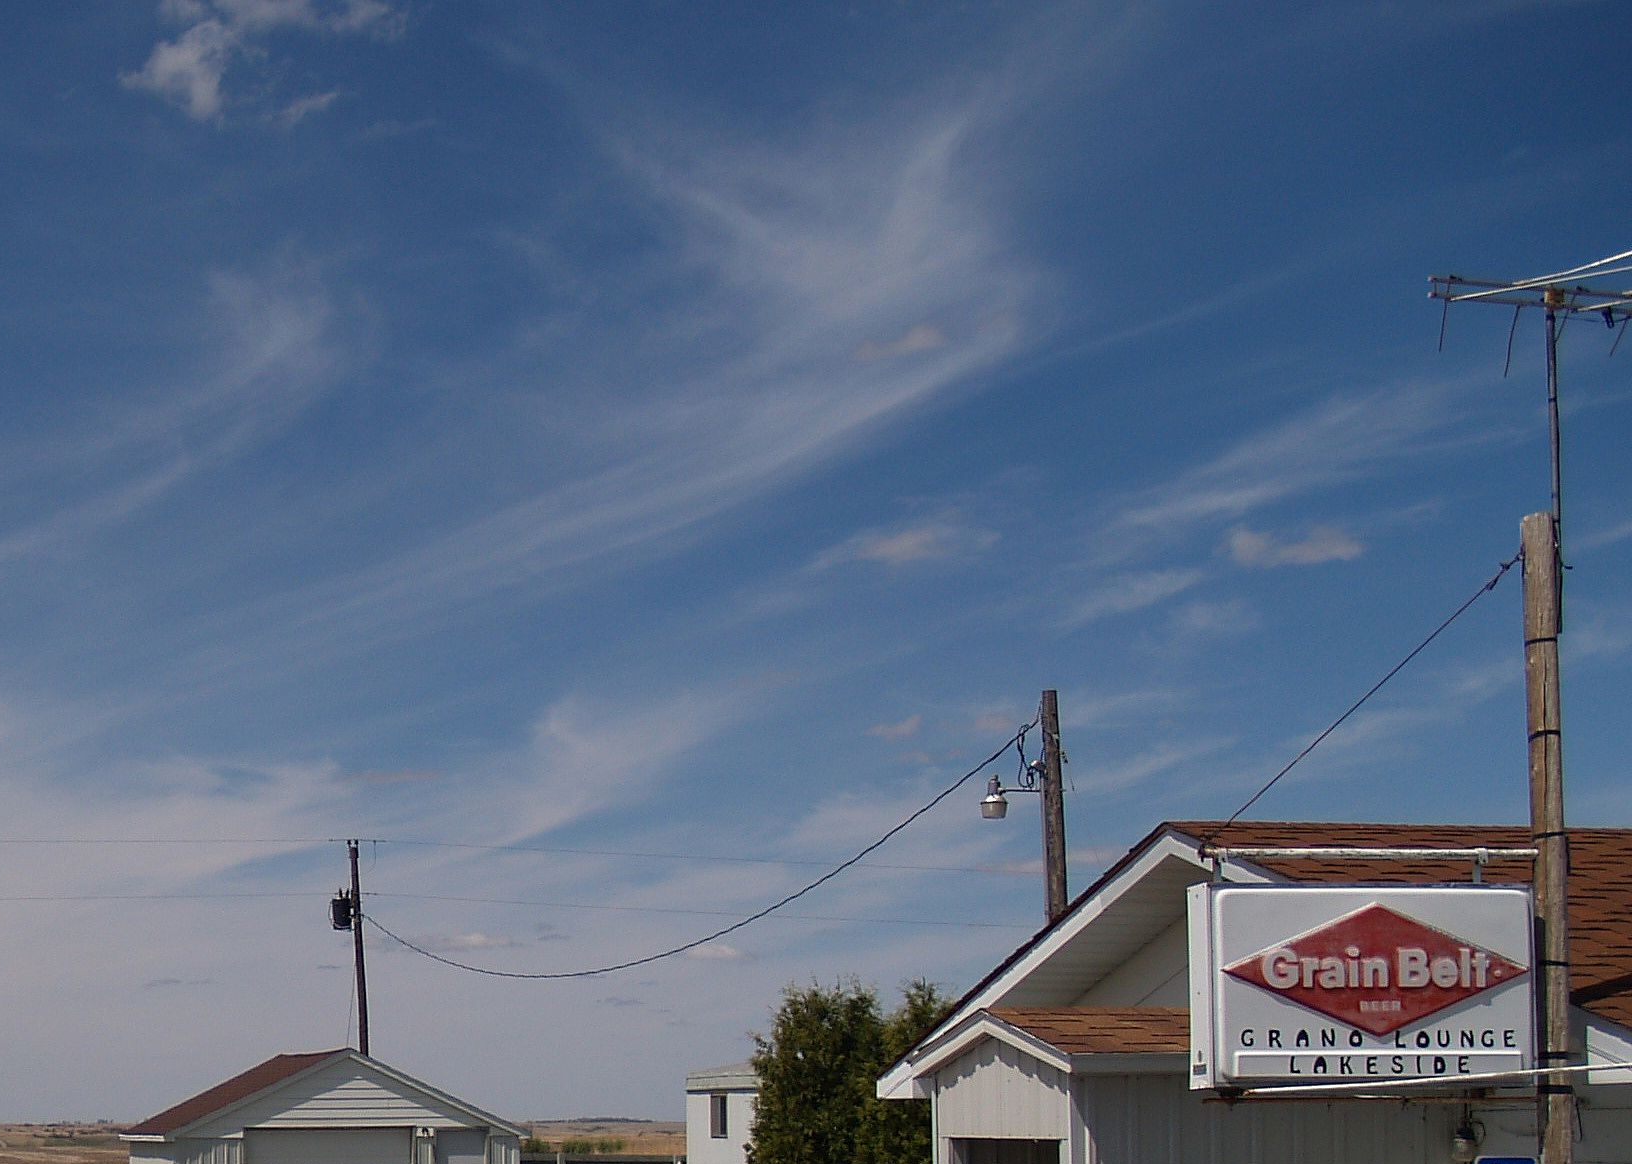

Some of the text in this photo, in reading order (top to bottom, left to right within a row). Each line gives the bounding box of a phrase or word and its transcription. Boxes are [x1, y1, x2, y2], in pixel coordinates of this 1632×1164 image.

[1261, 946, 1490, 989] Grain Belt
[1241, 1029, 1517, 1049] GRANO LOUNGE
[1289, 1055, 1471, 1076] LAKESIDE
